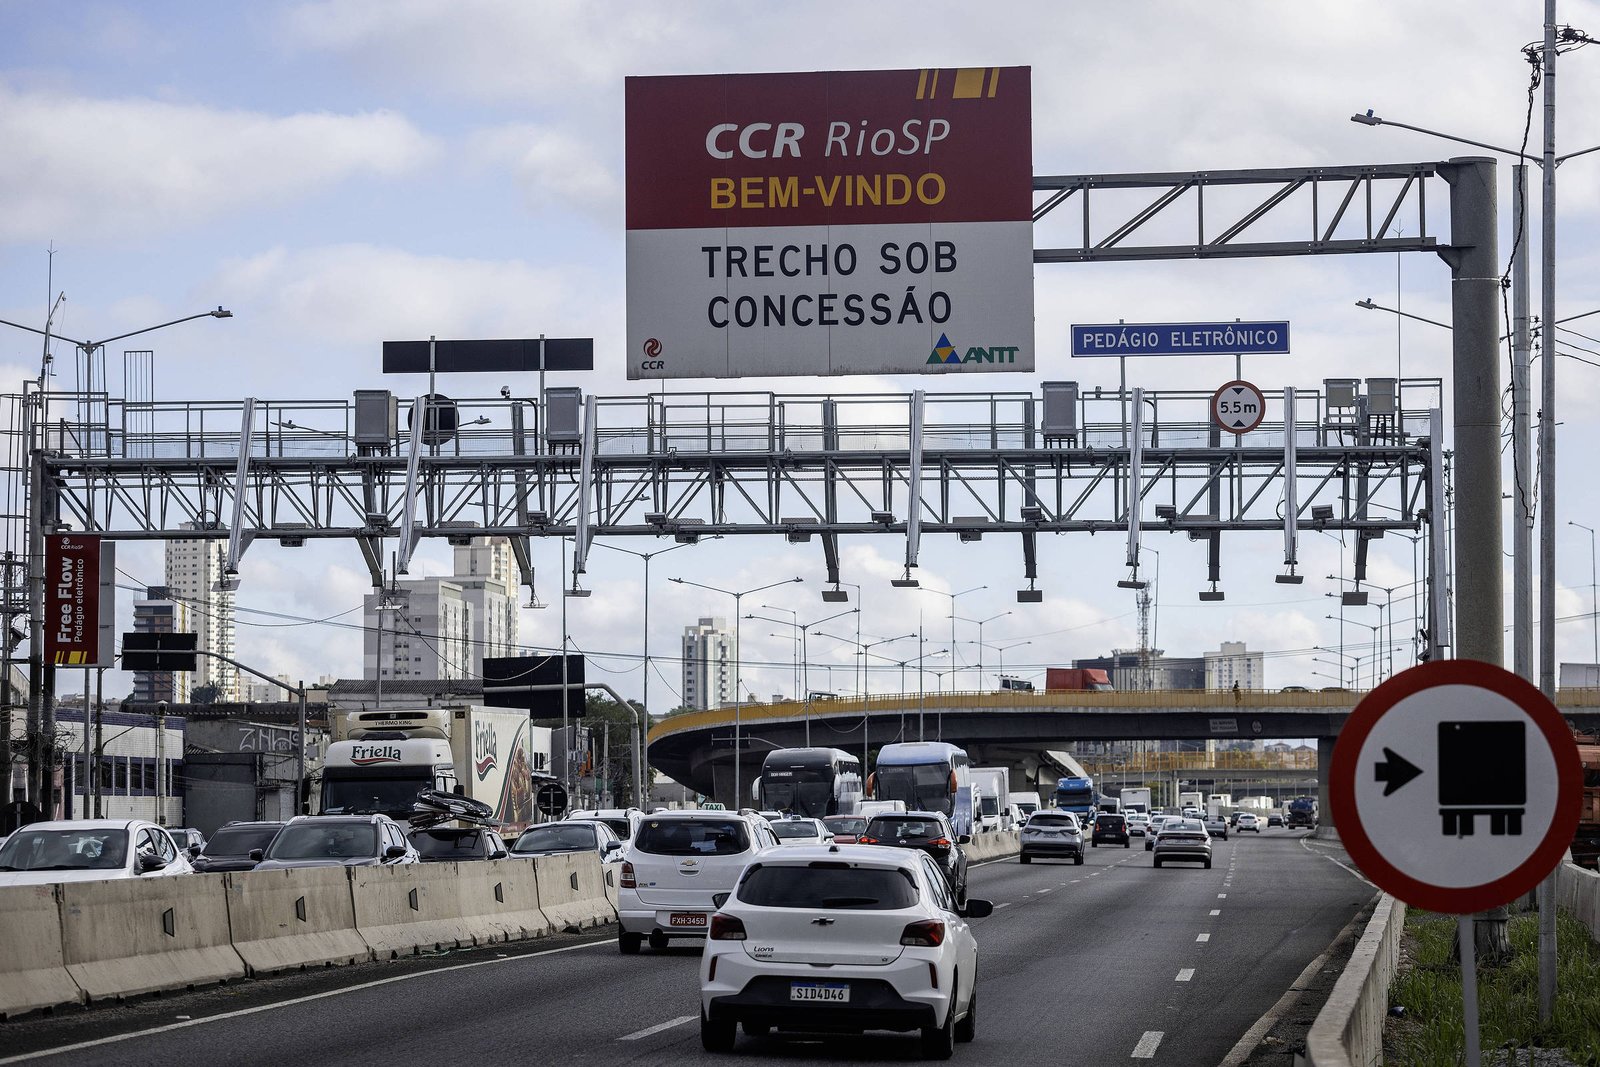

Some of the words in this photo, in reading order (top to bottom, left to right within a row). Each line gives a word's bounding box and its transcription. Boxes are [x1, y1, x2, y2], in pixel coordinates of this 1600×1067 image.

[705, 122, 805, 159] CCR
[824, 118, 951, 157] RioSP
[710, 172, 946, 209] BEM-VINDO
[701, 243, 857, 278] TRECHO
[879, 240, 957, 274] SOB
[961, 346, 1020, 364] ANTT
[1083, 328, 1159, 348] PEDÁGIO
[1171, 326, 1278, 347] ELETRÔNICO
[641, 360, 665, 370] CCR
[58, 556, 73, 599] Flow
[75, 558, 84, 604] eletrônico
[57, 603, 72, 643] Free
[74, 606, 85, 643] Pedágio
[351, 745, 402, 760] Friella
[475, 720, 498, 763] Friella
[704, 803, 722, 811] TAXI
[796, 988, 844, 1001] SID4D46
